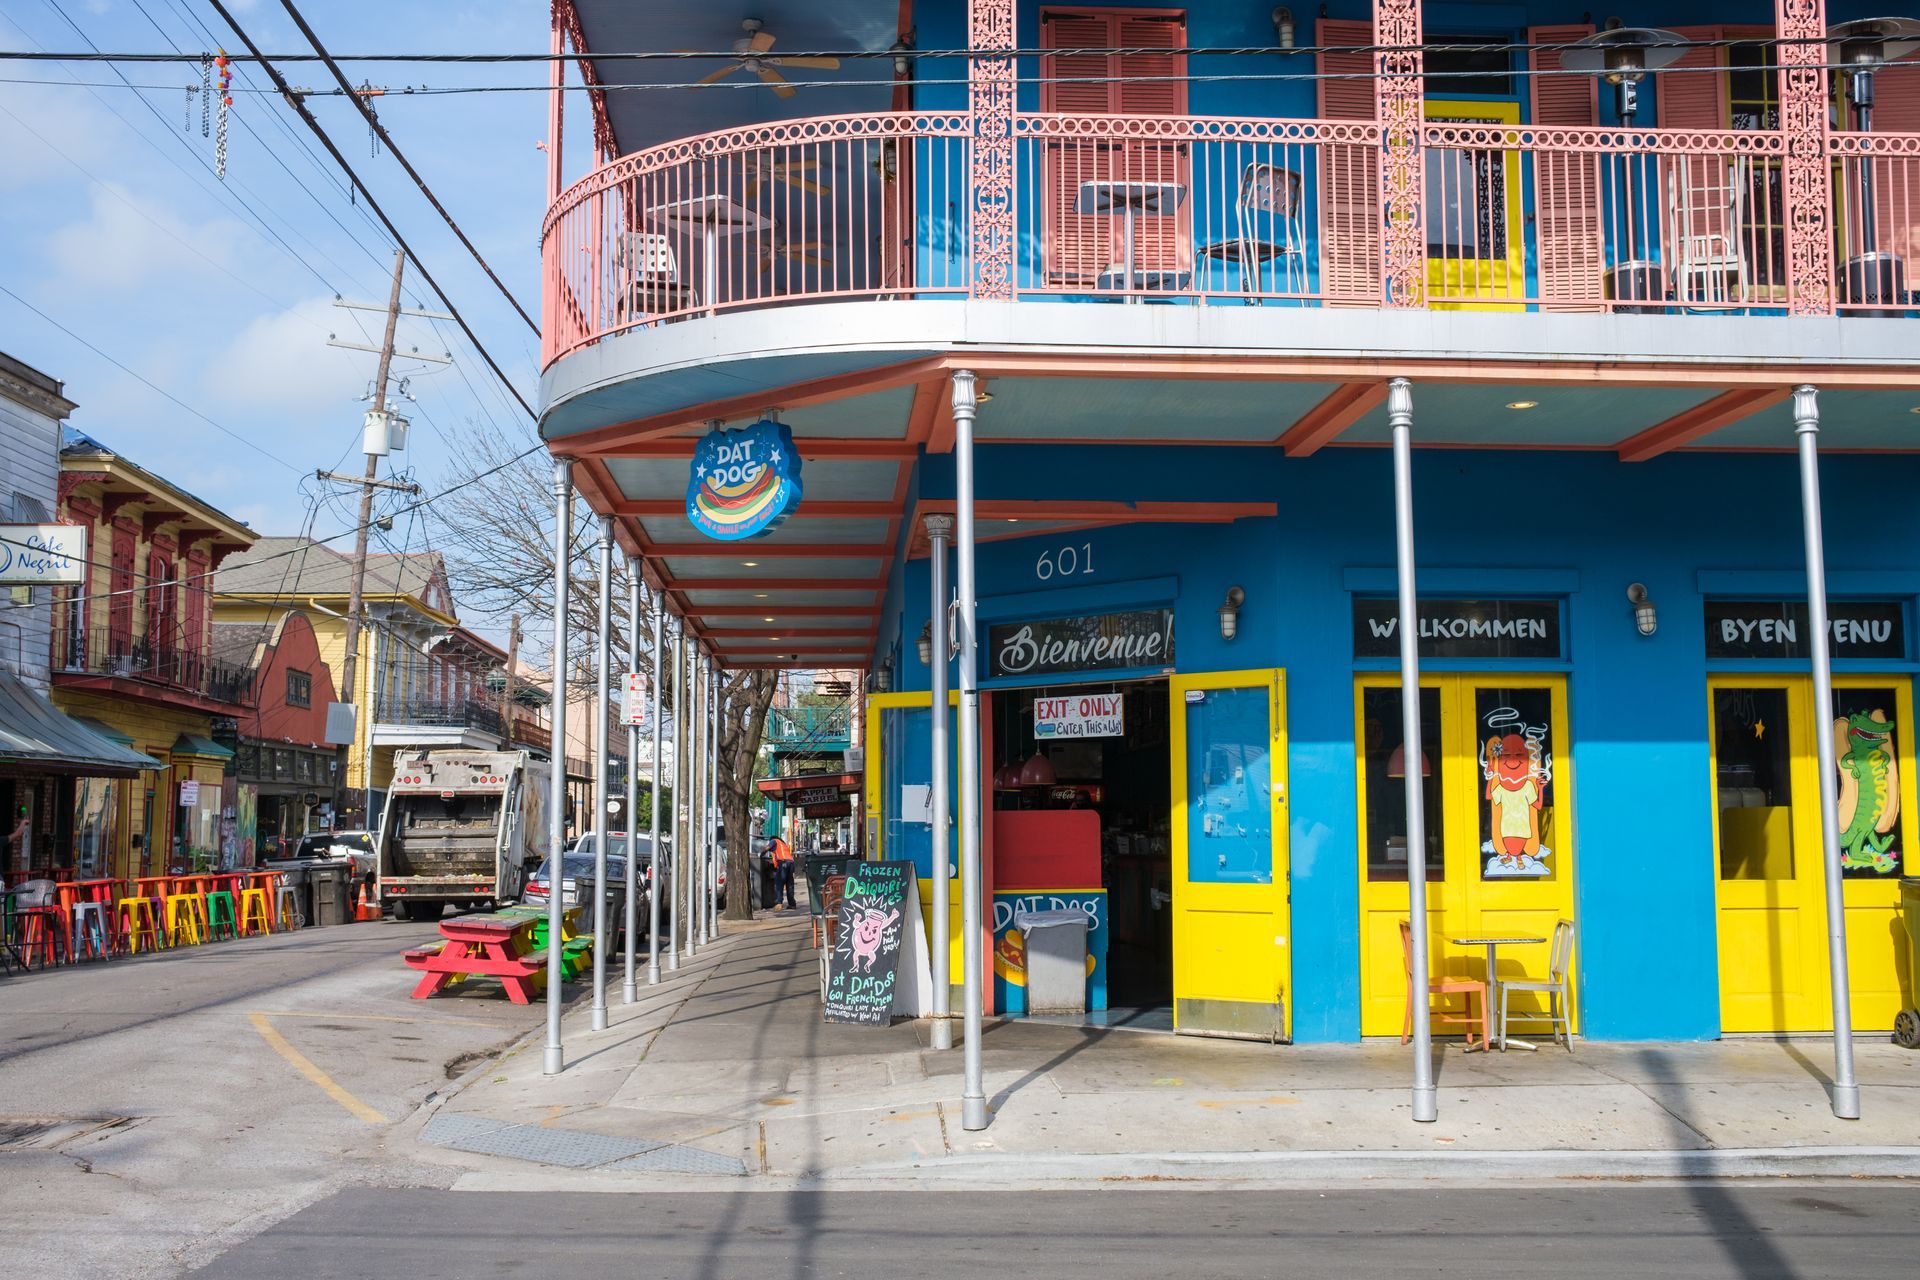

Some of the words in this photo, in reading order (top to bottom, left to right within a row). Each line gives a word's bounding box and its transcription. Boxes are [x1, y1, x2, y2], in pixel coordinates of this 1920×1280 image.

[717, 439, 755, 465] DAT
[713, 460, 762, 491] DOG
[27, 535, 64, 556] Cafe
[18, 553, 72, 575] Negril
[1036, 542, 1095, 580] 601
[1368, 616, 1548, 640] WLKOMMEN
[1720, 617, 1797, 644] BYEN
[999, 613, 1174, 673] Bienvenue!
[1037, 699, 1069, 720] EXIT
[1079, 696, 1120, 718] ONLY
[1056, 721, 1084, 737] ENTER
[802, 788, 833, 796] APPLE
[859, 863, 902, 878] FROZEN
[832, 971, 846, 986] at
[828, 989, 844, 1001] 601
